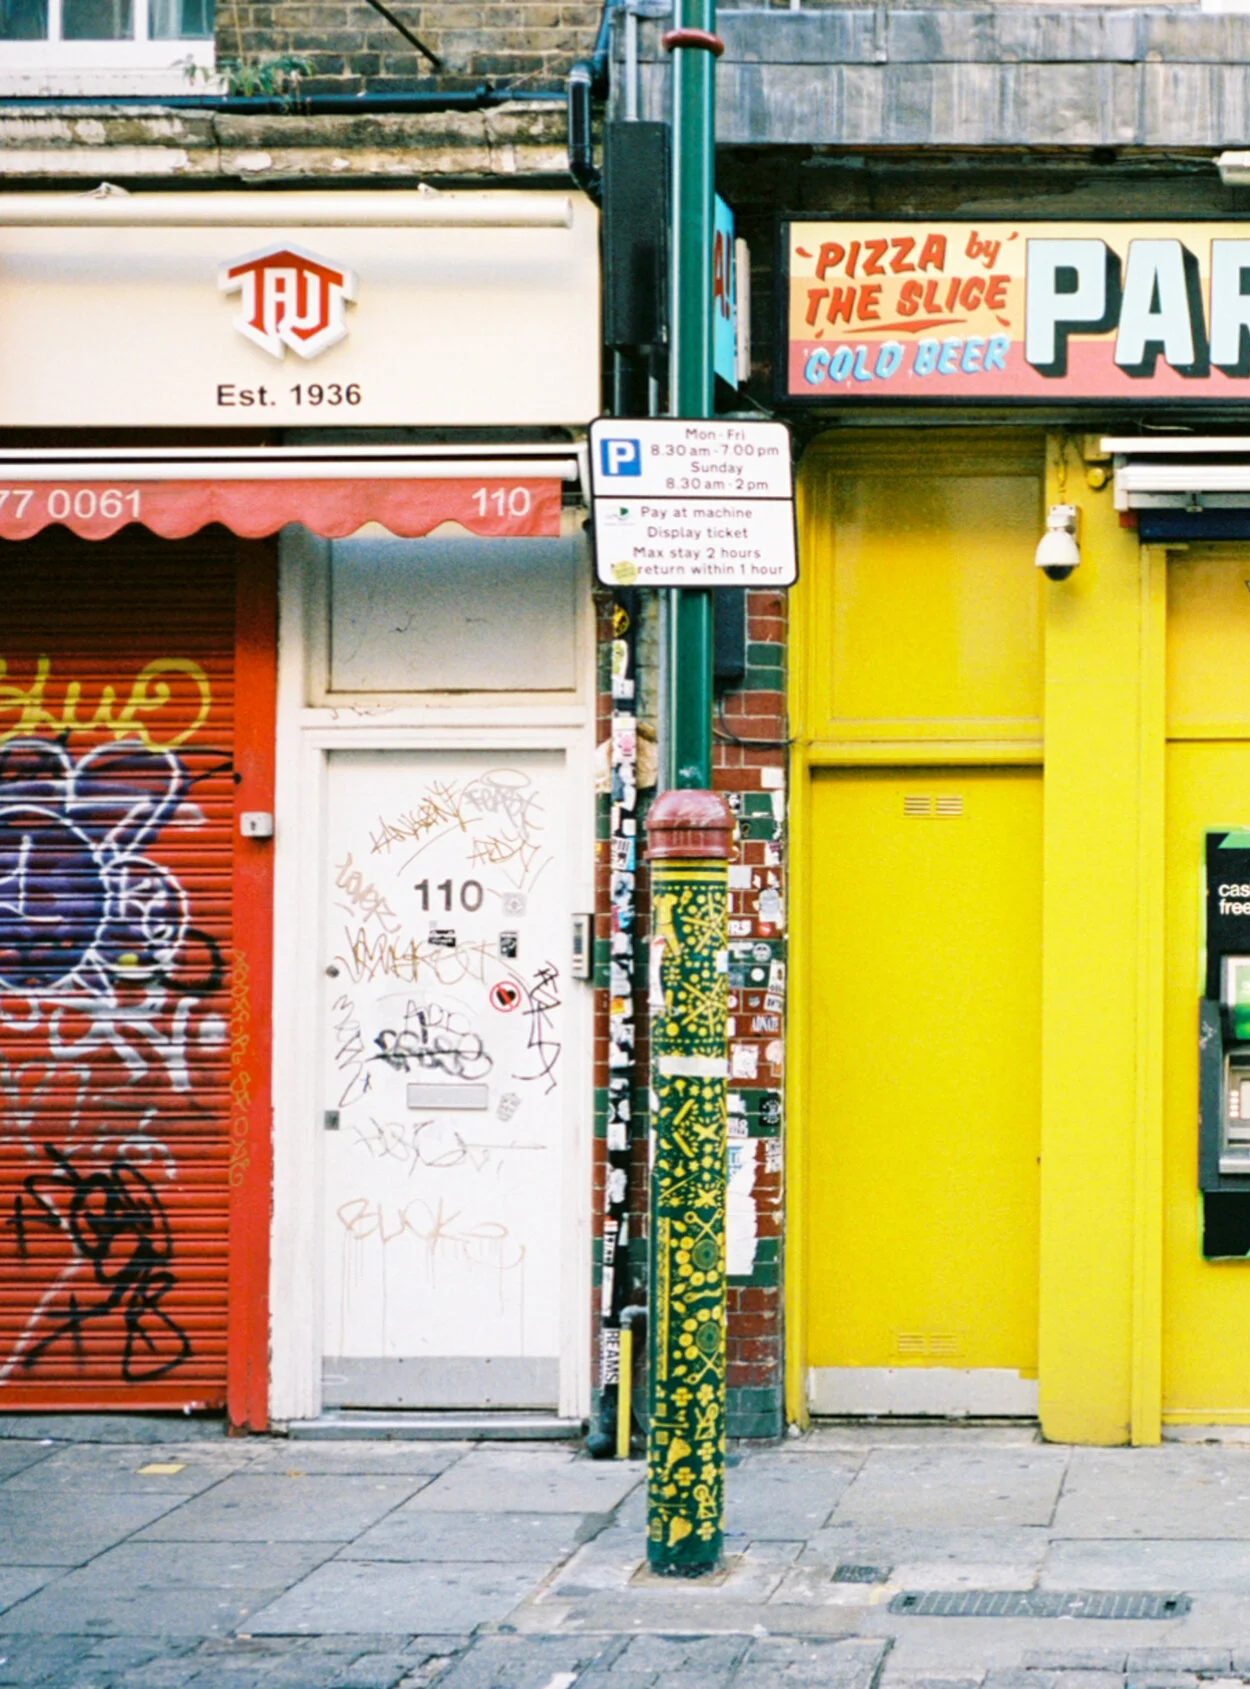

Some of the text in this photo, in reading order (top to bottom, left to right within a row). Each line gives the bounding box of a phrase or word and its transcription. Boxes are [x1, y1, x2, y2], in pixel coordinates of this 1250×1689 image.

[815, 231, 1001, 280] PIZZA by
[805, 274, 1011, 326] THE SLICE
[803, 332, 1011, 385] COLD BEER
[216, 384, 362, 407] Est. 1936
[685, 428, 716, 441] Mon
[727, 428, 745, 441] Fri
[607, 441, 636, 474] P
[691, 461, 744, 475] Sunday
[48, 489, 141, 519] 0061
[472, 487, 532, 517] 110
[641, 506, 753, 520] Pay at machine
[647, 526, 748, 540] Display ticket
[633, 547, 761, 561] Max stay 2 hours
[638, 564, 685, 576] return
[691, 564, 736, 576] within
[741, 564, 746, 575] 1
[750, 564, 783, 576] hour
[414, 879, 483, 911] 110
